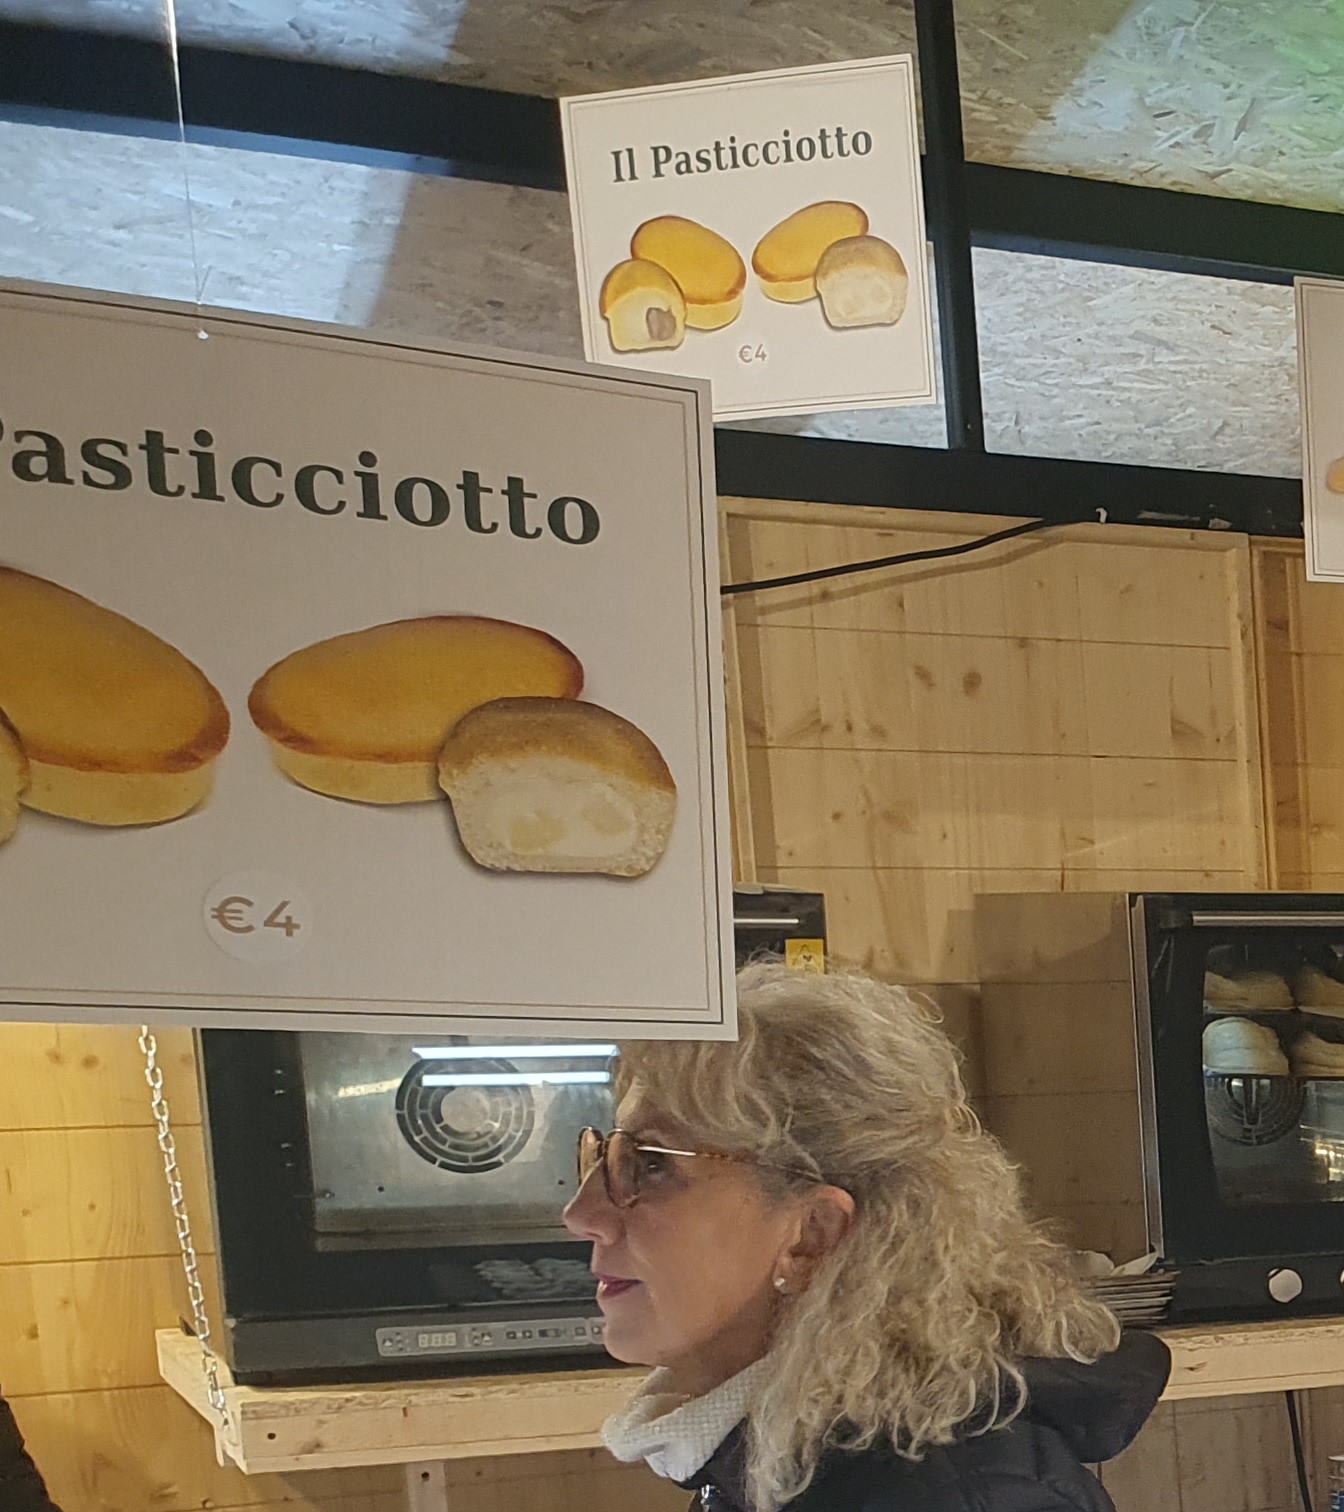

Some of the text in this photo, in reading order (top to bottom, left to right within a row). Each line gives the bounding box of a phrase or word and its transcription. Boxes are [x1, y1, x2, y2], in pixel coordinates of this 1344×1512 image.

[611, 126, 873, 183] Il Pasticciotto
[738, 344, 767, 363] €4
[0, 417, 600, 545] asticciotto
[210, 896, 301, 937] €4
